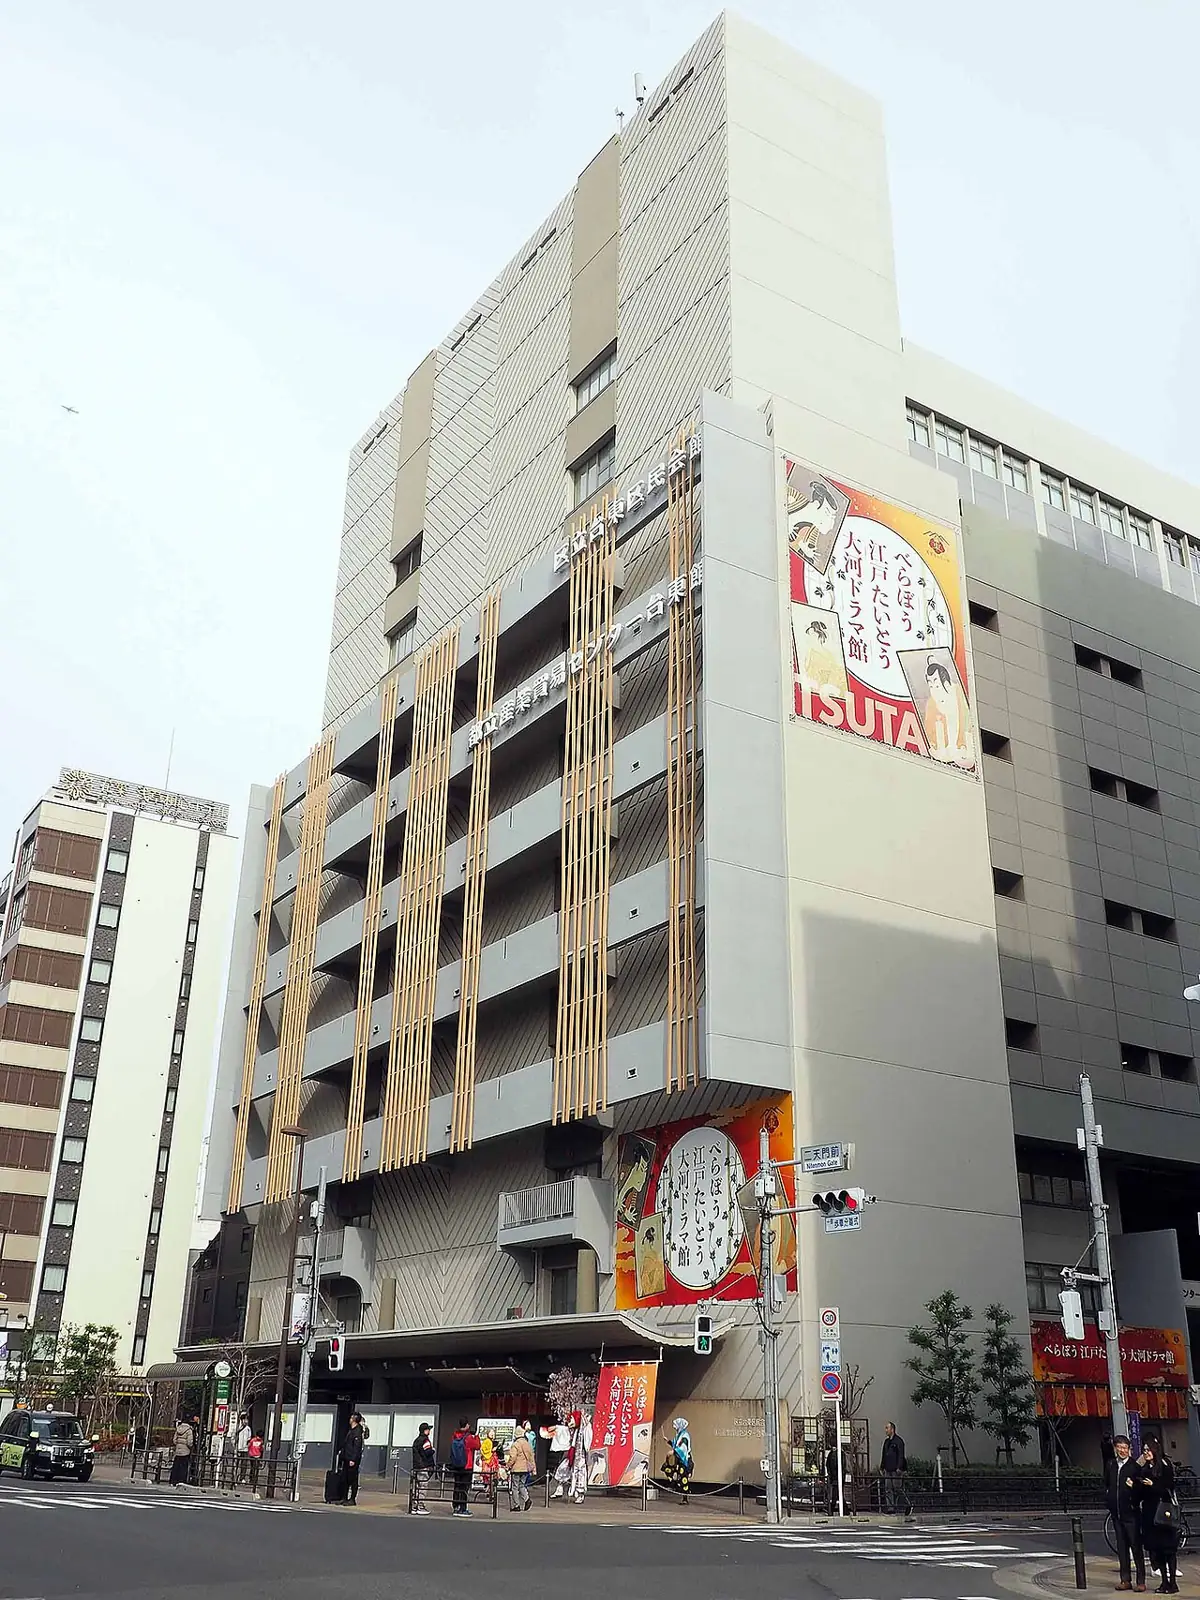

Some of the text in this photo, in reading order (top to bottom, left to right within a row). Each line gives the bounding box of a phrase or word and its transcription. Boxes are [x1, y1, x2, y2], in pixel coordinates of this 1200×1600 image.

[843, 531, 868, 664] 大河ドラマ館
[869, 539, 891, 669] 江戸たいとう
[894, 553, 915, 632] べらぼう
[709, 1142, 722, 1220] べらぼう
[804, 1146, 839, 1161] 二天門前
[678, 1149, 690, 1267] 大河ドラマ館
[693, 1145, 706, 1266] 江戸たいとう
[825, 1314, 834, 1323] 30
[1044, 1344, 1077, 1358] べらぼう
[1129, 1348, 1175, 1364] 大河ドラマ館
[603, 1376, 621, 1445] 大河ドラマ館
[620, 1376, 634, 1446] 江戸たいとう
[636, 1376, 648, 1422] べらぼう
